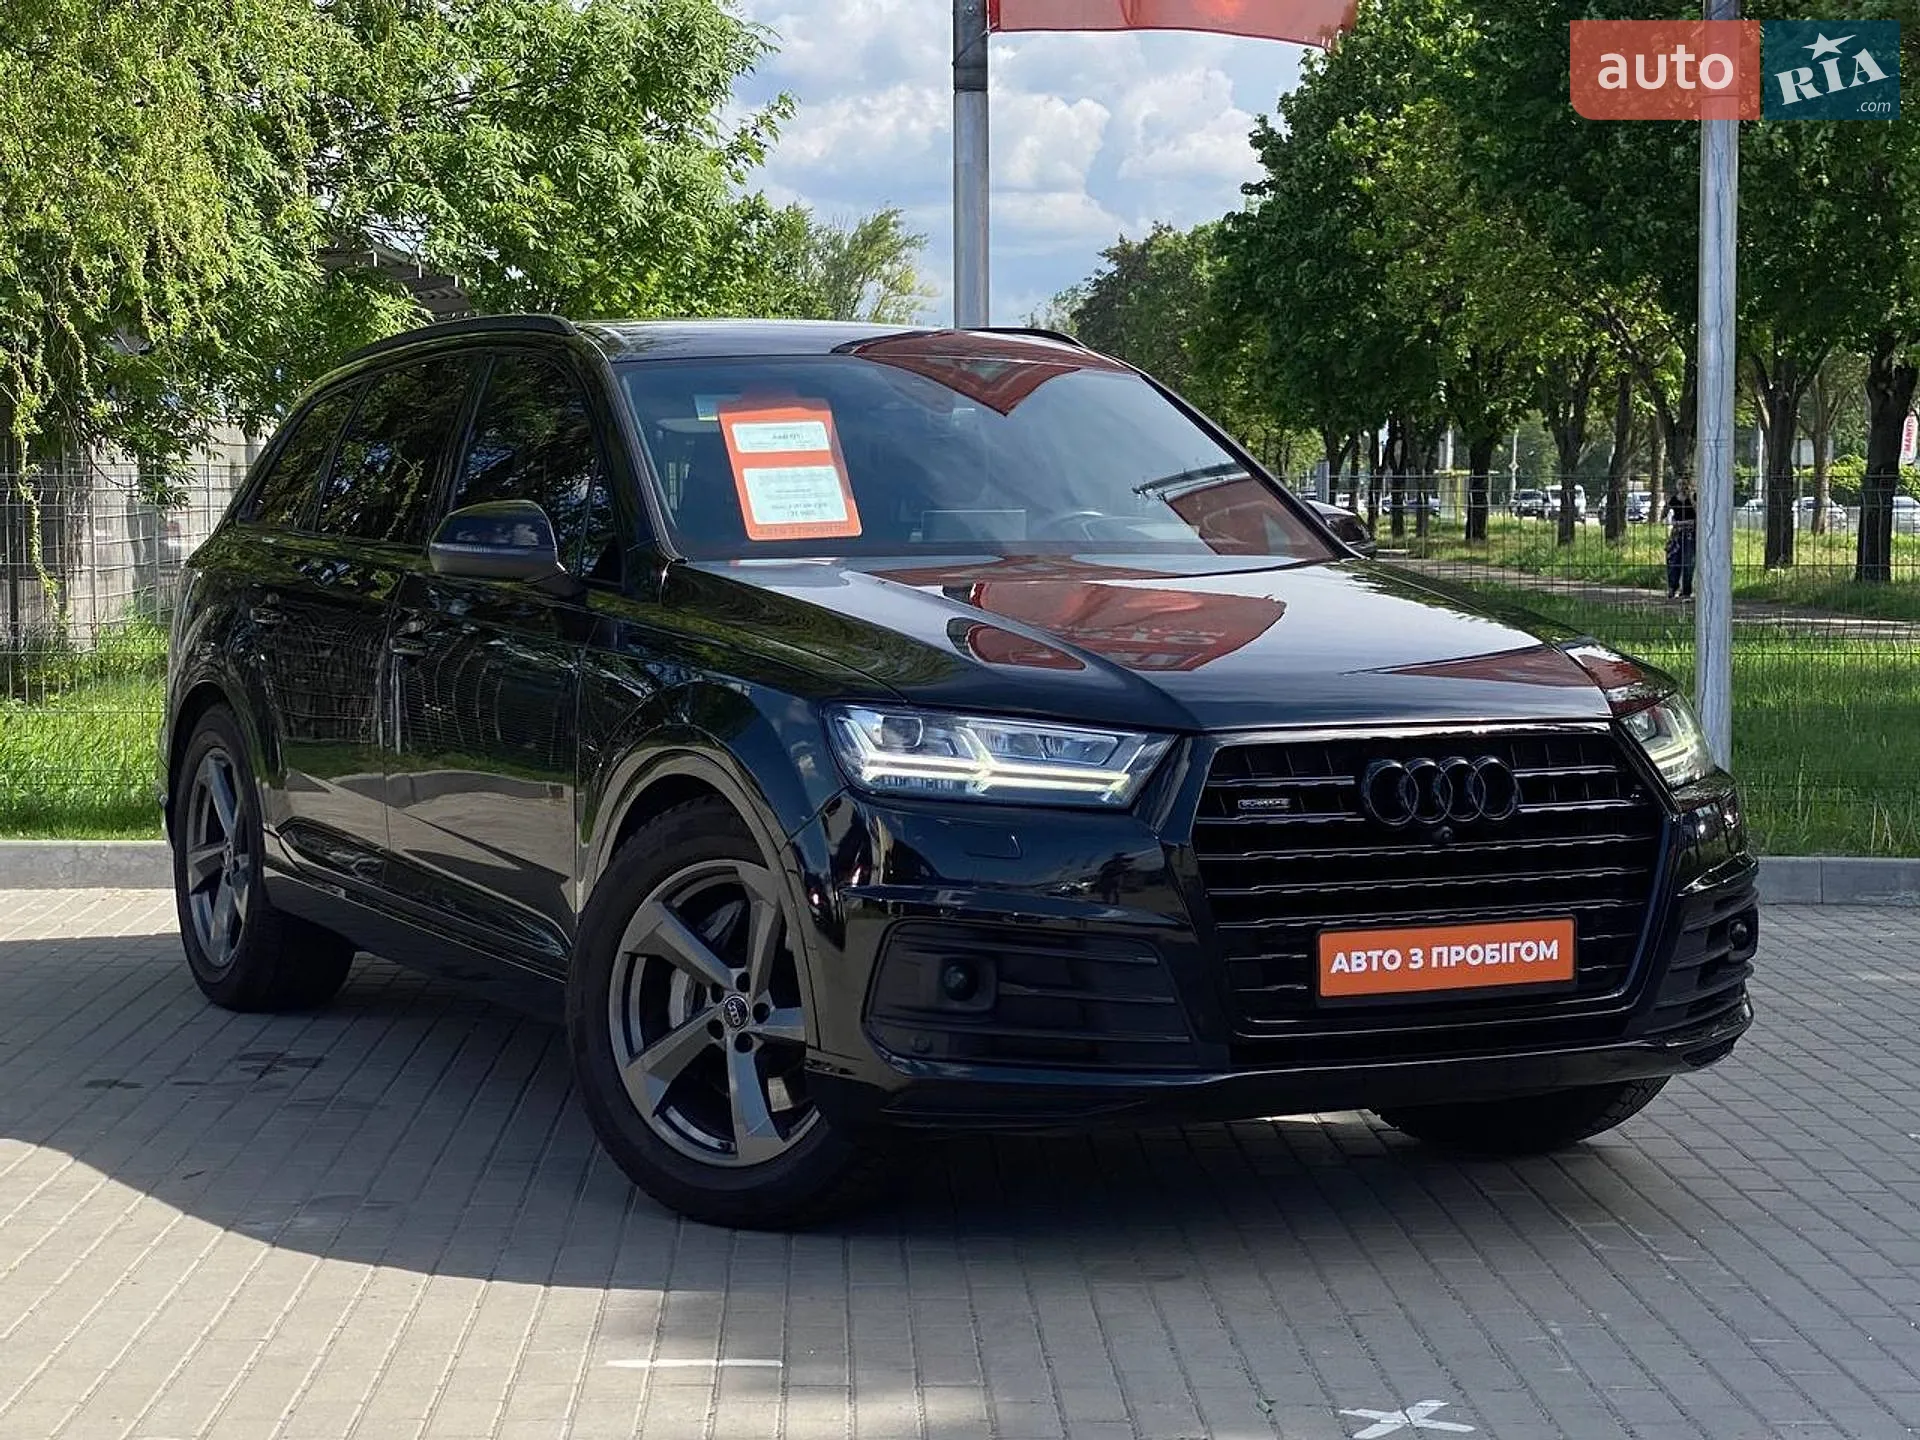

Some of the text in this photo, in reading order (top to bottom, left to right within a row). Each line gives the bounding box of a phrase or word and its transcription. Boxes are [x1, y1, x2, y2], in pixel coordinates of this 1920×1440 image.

[1330, 939, 1559, 974] АВТО З ПРОБІГОМ
